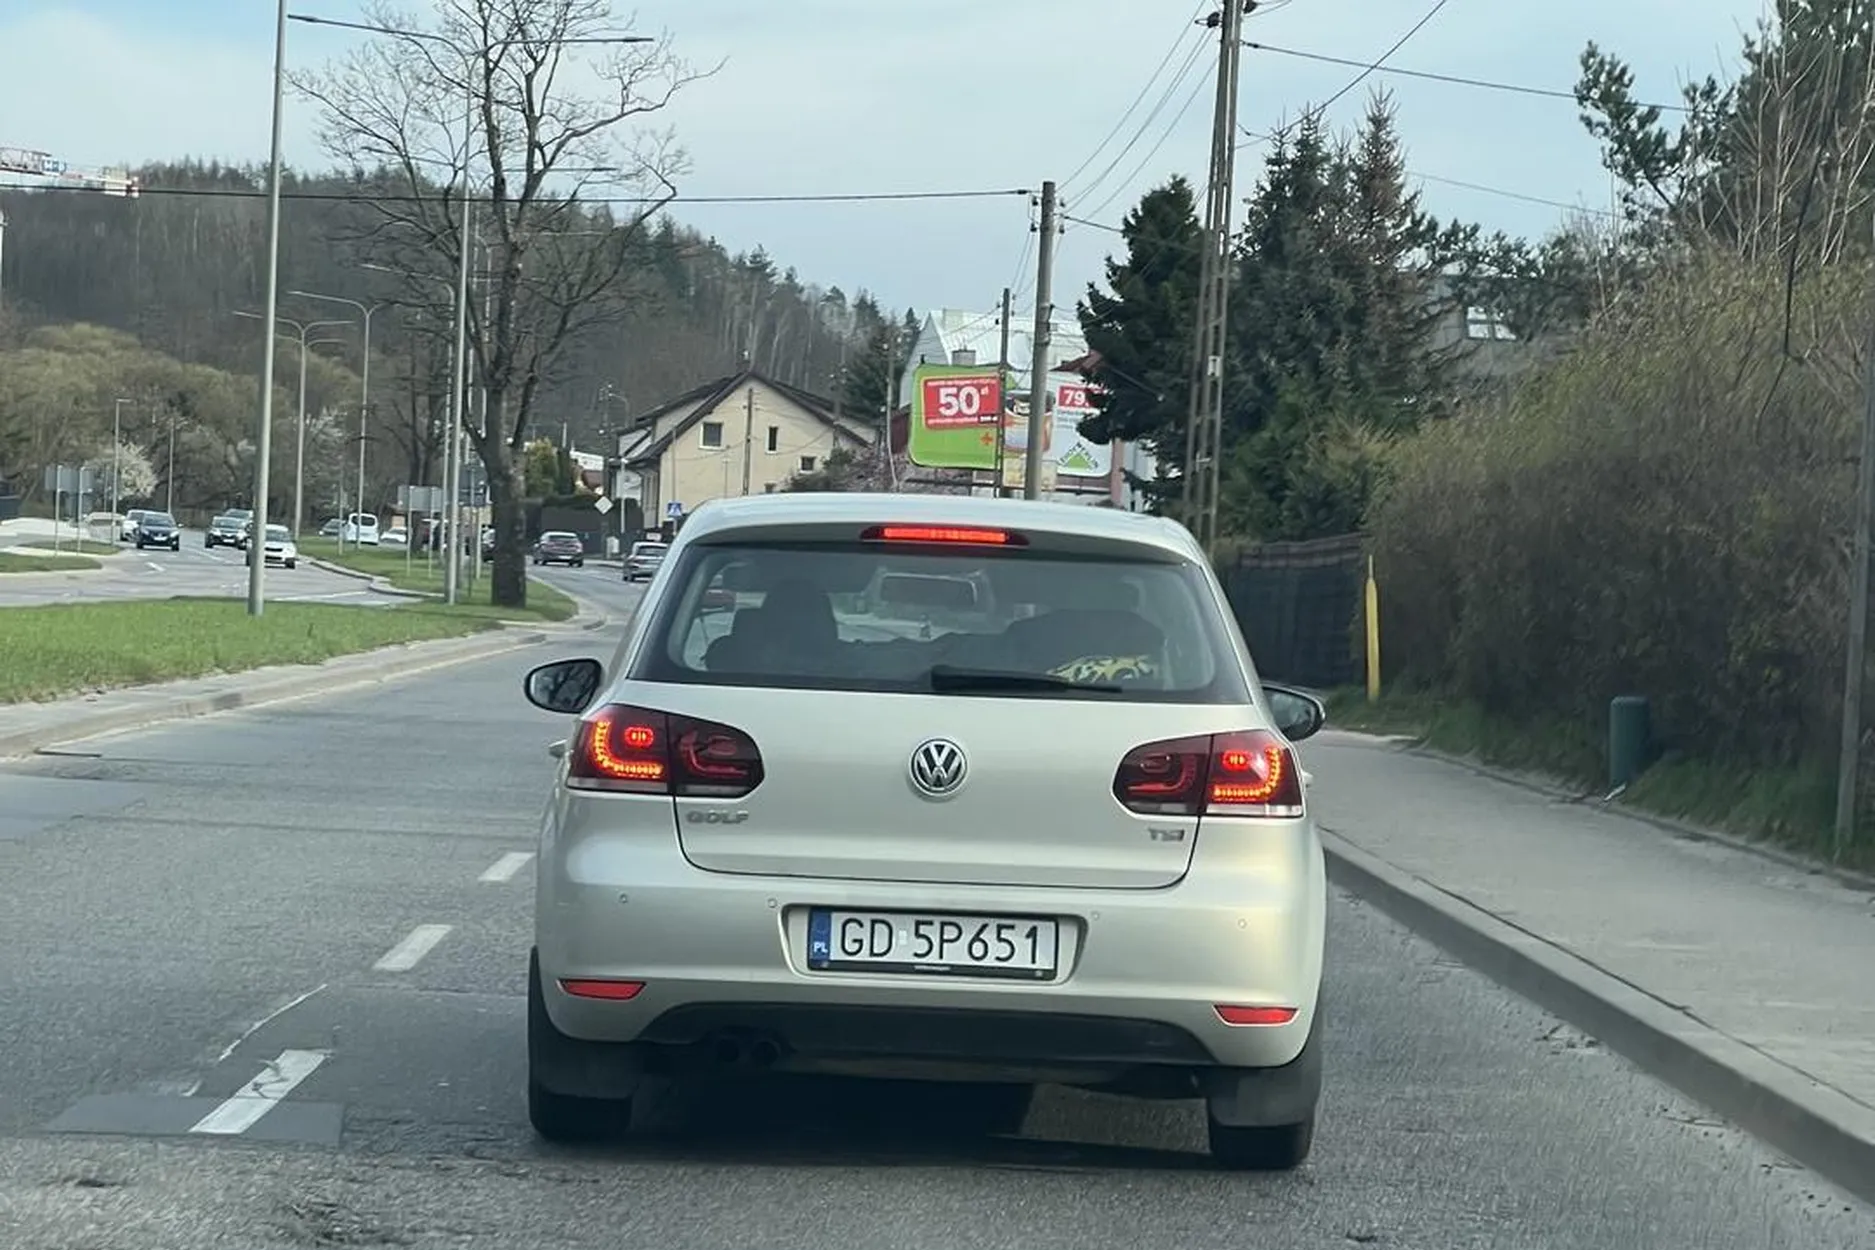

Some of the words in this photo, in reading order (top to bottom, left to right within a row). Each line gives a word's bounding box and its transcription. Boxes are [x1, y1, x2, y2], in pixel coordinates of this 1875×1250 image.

[938, 386, 980, 416] 50
[686, 810, 749, 823] GOLF
[813, 942, 829, 953] PL
[840, 918, 894, 958] GD
[912, 919, 1039, 965] 5P651
